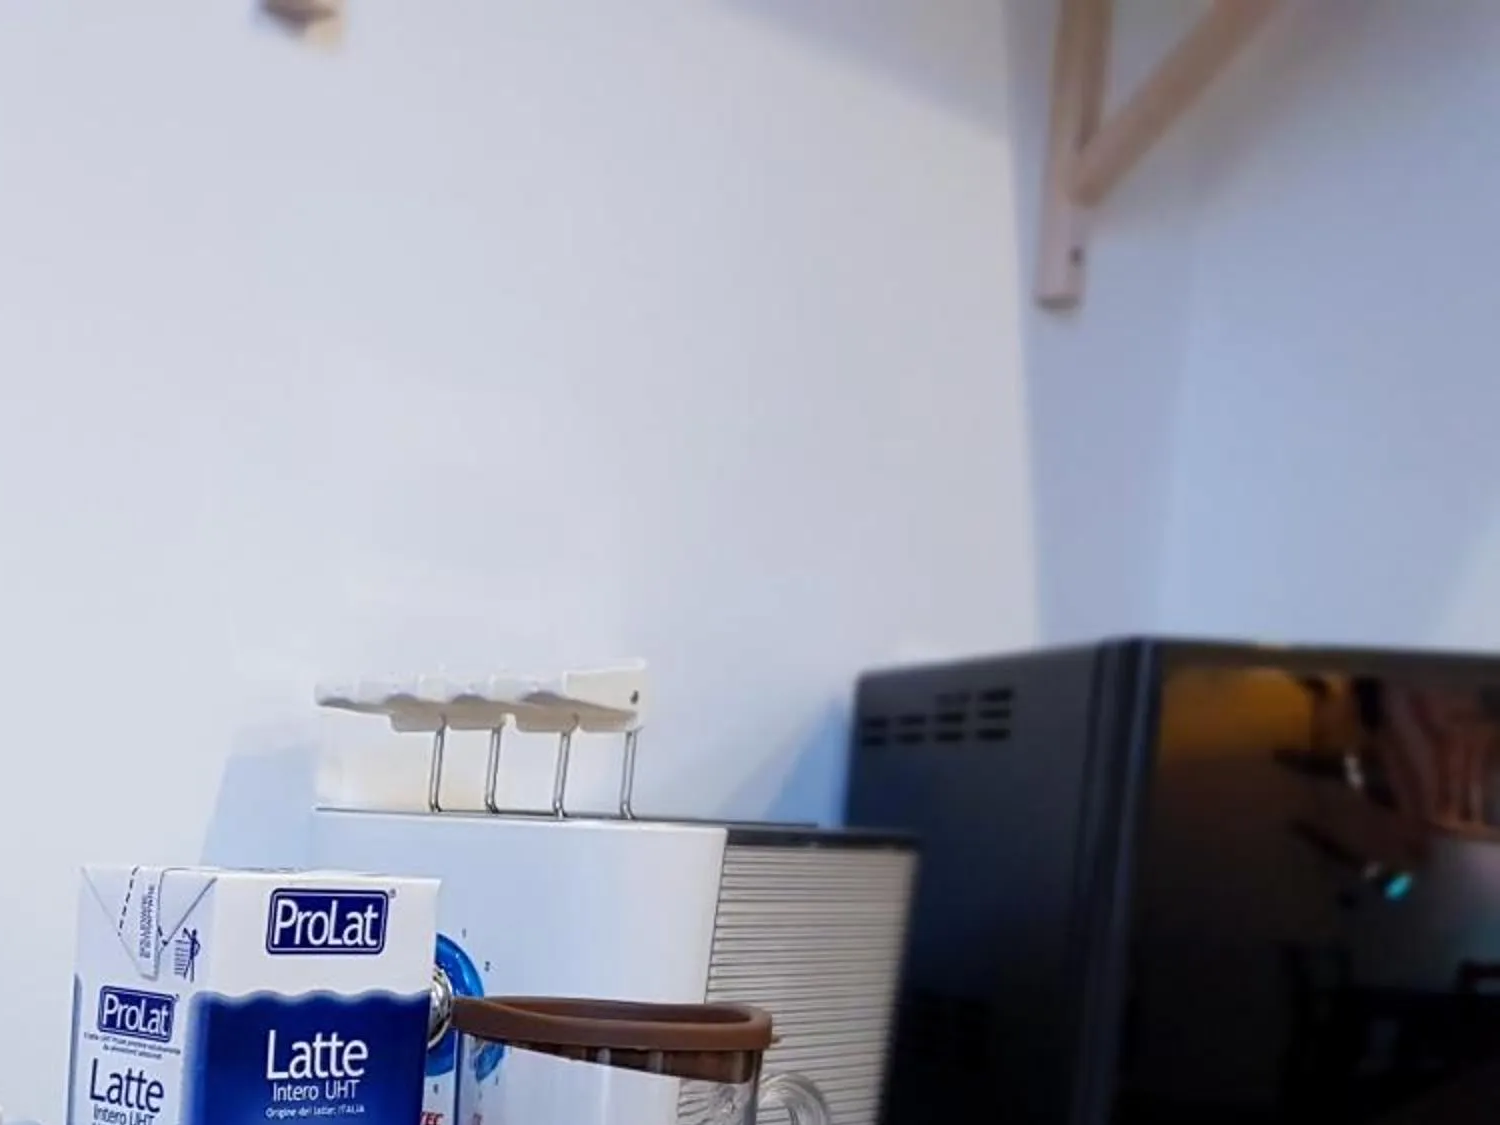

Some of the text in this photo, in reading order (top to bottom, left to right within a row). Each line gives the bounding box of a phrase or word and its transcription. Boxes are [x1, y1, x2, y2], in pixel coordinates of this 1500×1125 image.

[273, 898, 379, 946] ProLat
[102, 993, 169, 1036] ProLat
[266, 1029, 369, 1080] Latte
[89, 1057, 165, 1113] Latte
[272, 1079, 361, 1102] Intero UHT
[265, 1107, 297, 1119] Origine
